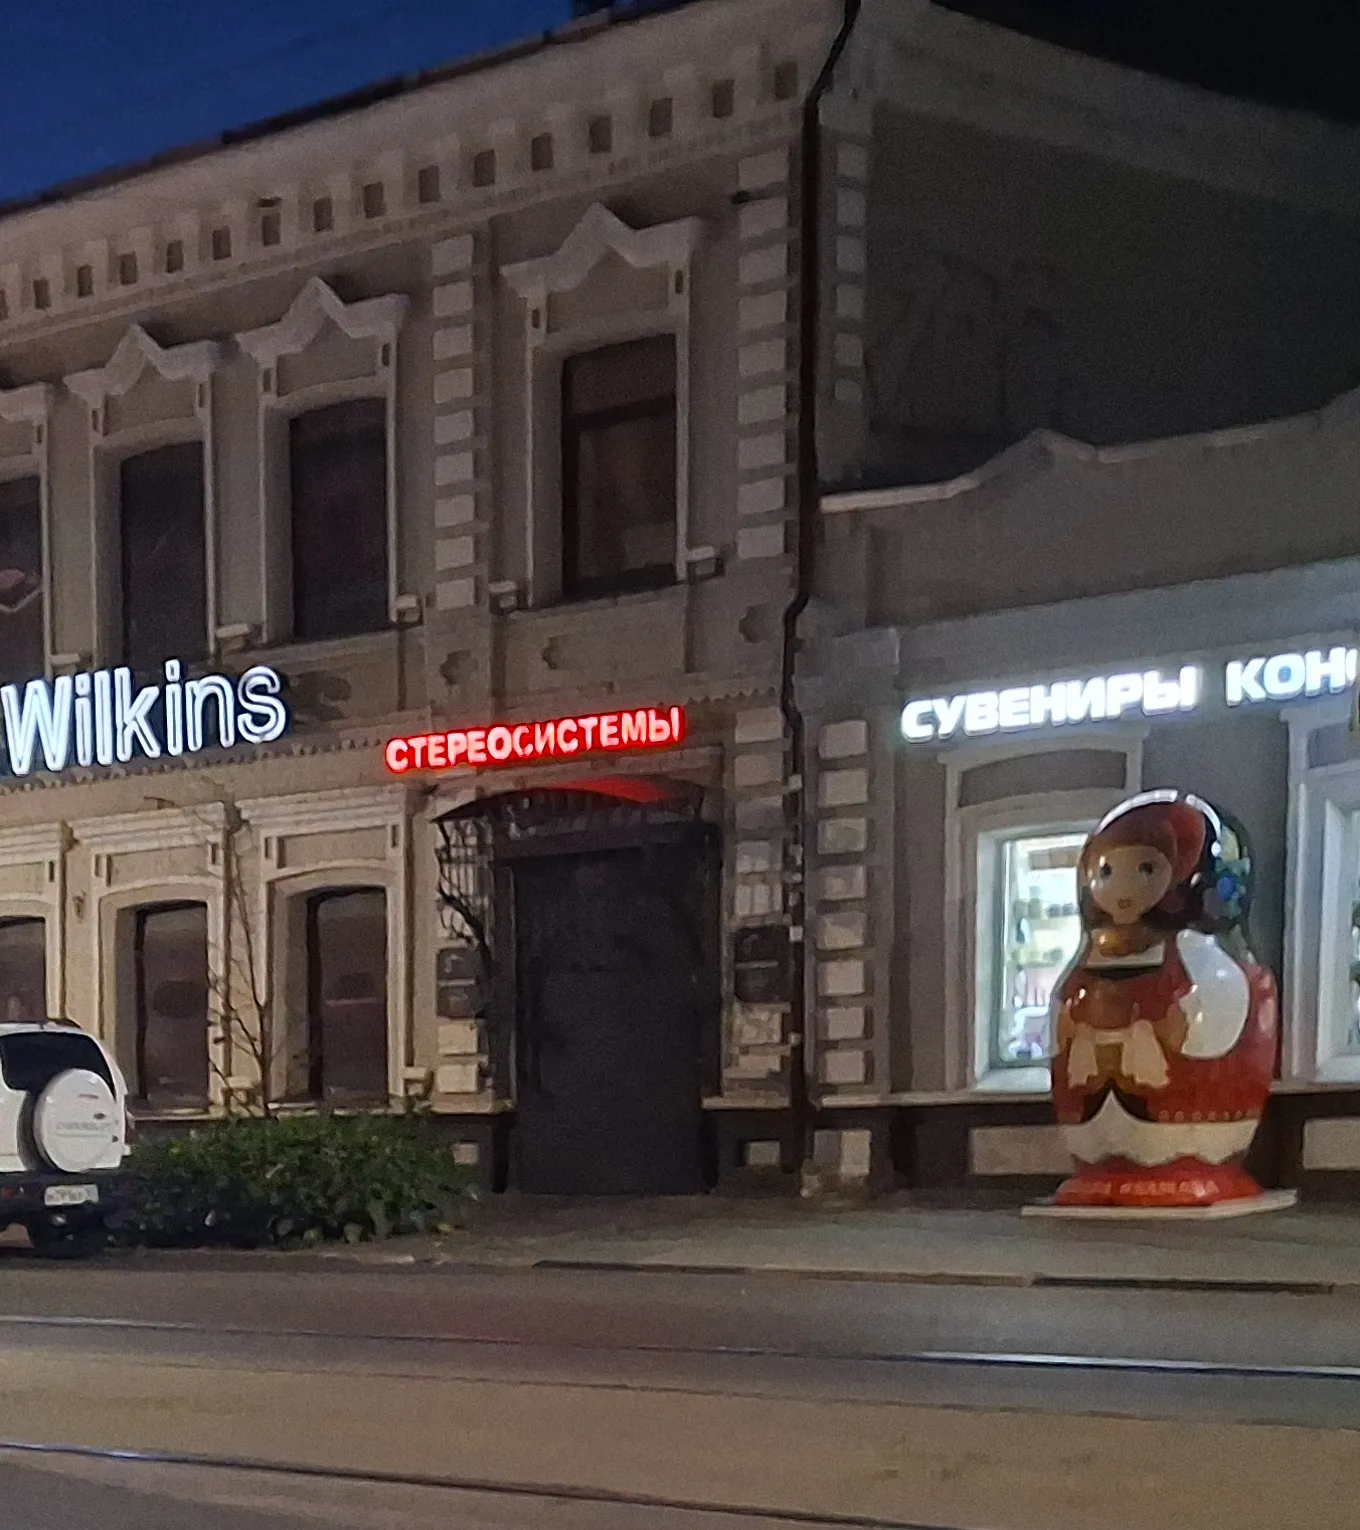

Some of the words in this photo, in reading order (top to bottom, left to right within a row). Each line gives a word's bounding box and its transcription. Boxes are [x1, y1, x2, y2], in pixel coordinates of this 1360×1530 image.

[0, 659, 286, 776] Wilkins
[386, 706, 679, 771] СТЕРЕОСИСТЕМЫ
[901, 665, 1198, 743] СУВЕНИРЫ
[1225, 646, 1358, 706] КОН
